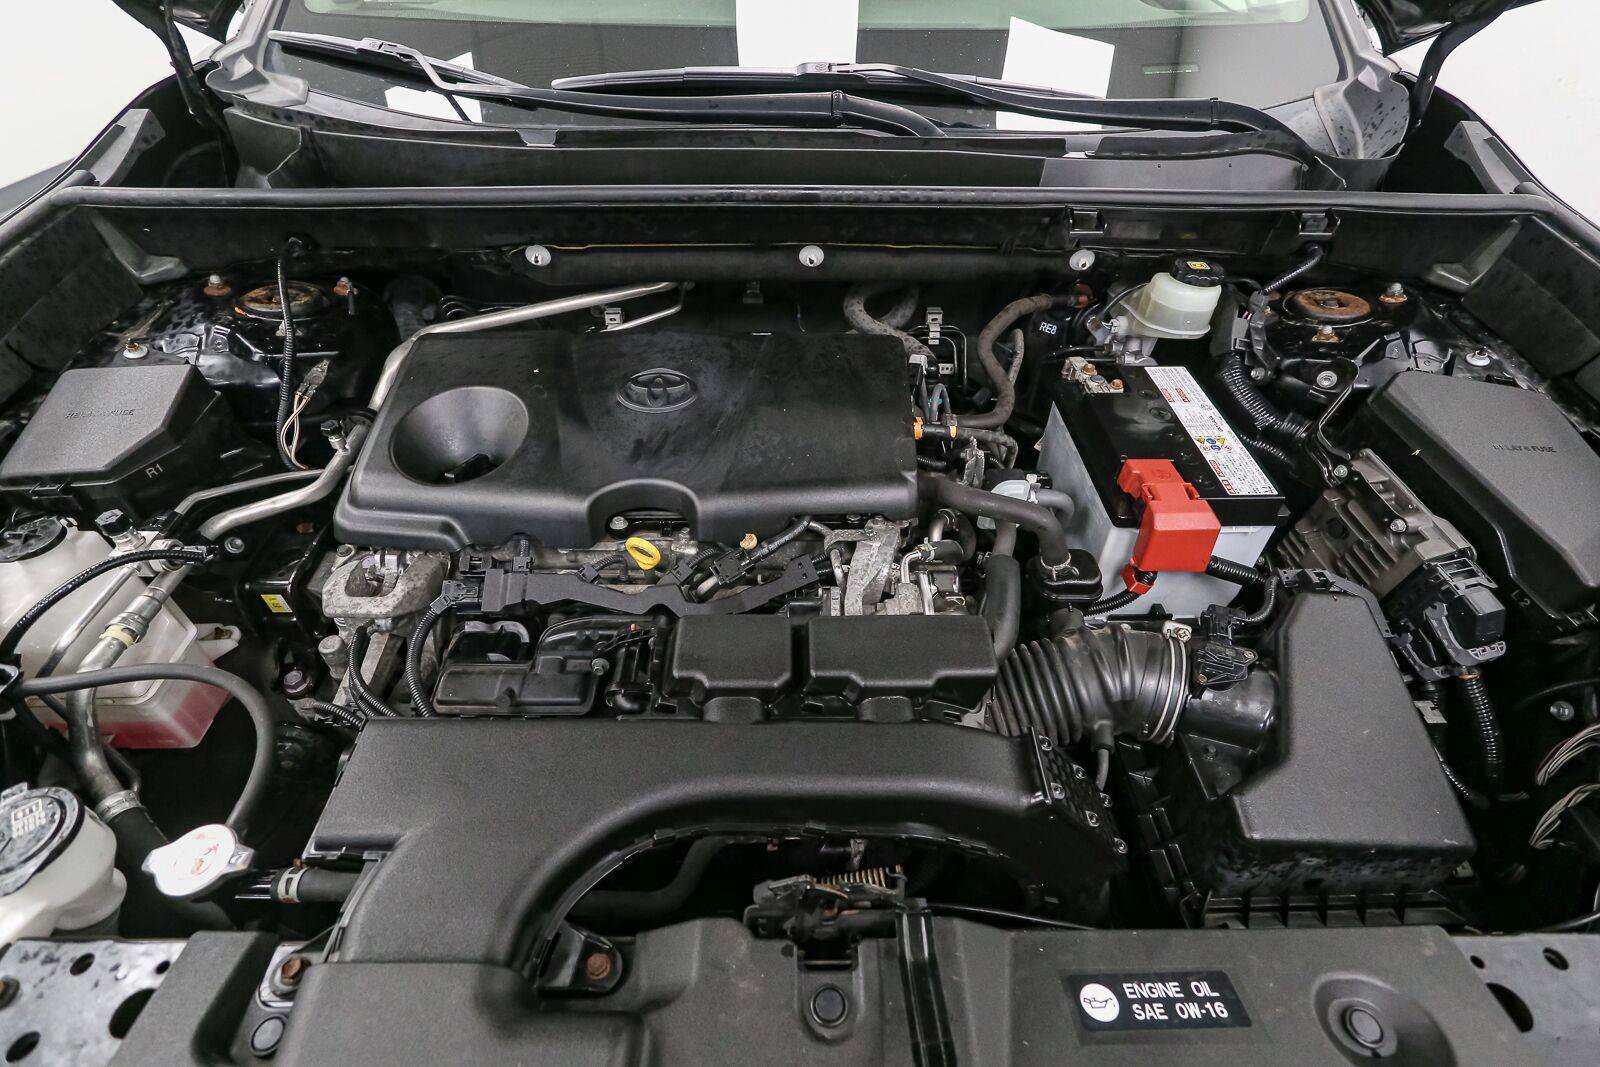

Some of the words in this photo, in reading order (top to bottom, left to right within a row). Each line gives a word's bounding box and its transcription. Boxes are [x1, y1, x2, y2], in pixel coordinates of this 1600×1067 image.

[1040, 322, 1057, 334] RE8
[145, 464, 163, 478] R1
[1123, 981, 1184, 999] ENGINE
[1191, 980, 1220, 998] OIL
[1132, 1002, 1169, 1020] SAE
[1175, 1001, 1229, 1020] 0W-16
